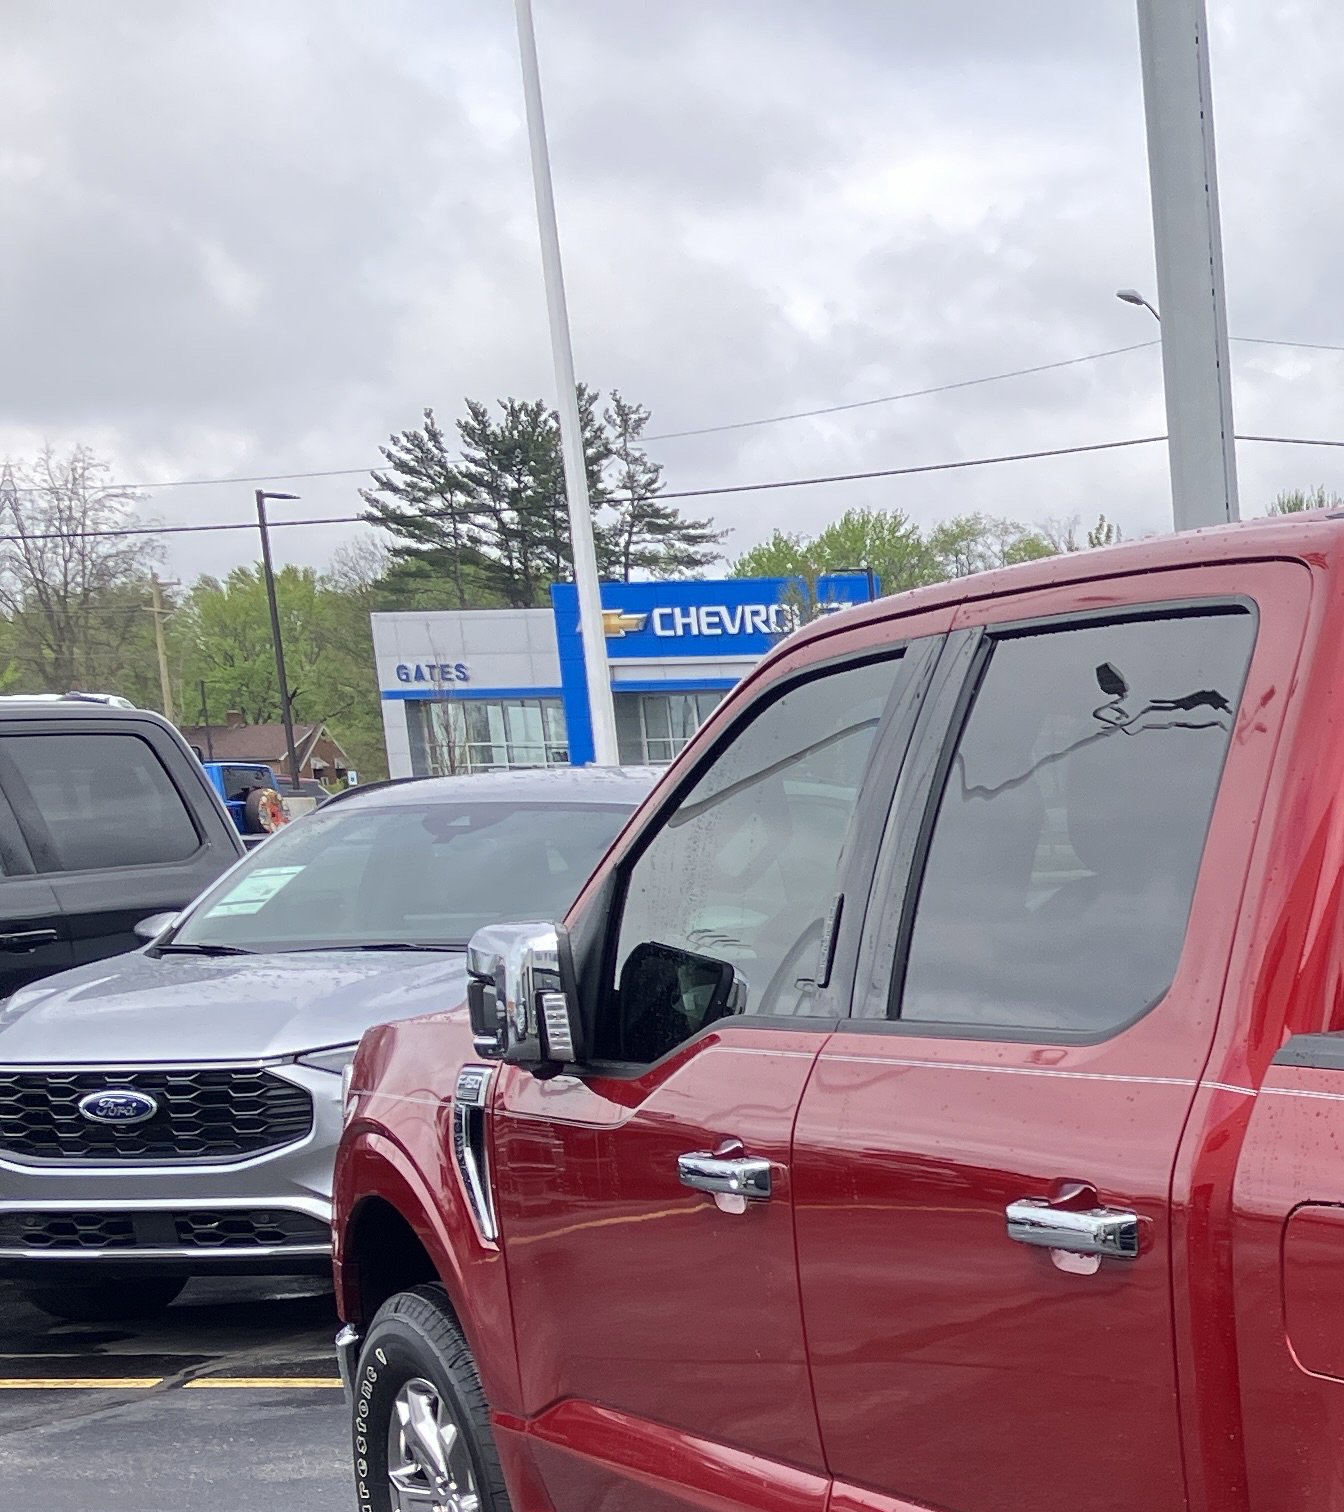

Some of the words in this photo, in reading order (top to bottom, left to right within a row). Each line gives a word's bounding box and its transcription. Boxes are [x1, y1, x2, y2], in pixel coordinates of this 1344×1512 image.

[652, 602, 854, 637] CHEVRO
[395, 662, 471, 682] GATES
[96, 1097, 137, 1116] Ford
